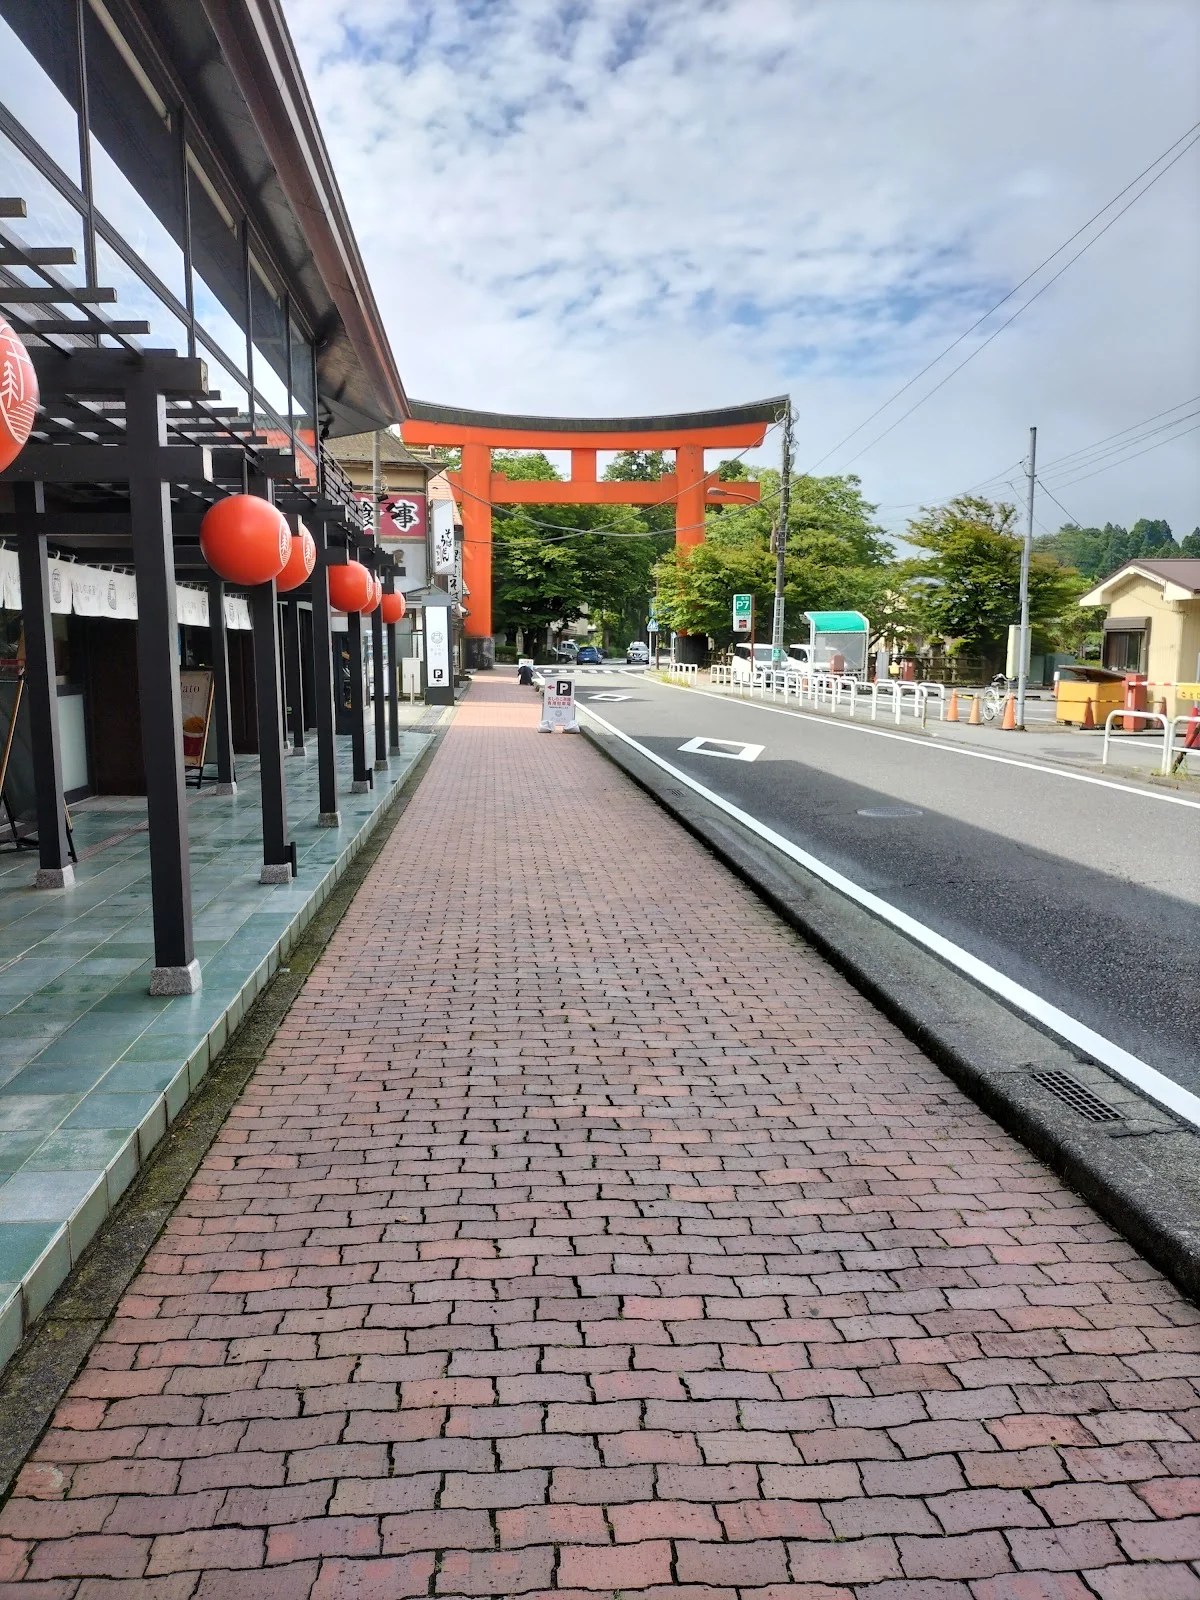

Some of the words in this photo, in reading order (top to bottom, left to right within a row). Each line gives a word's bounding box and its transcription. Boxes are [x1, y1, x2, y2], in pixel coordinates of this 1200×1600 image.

[445, 528, 452, 548] そば
[441, 534, 450, 562] うどん
[737, 601, 749, 609] P7
[558, 682, 570, 695] P
